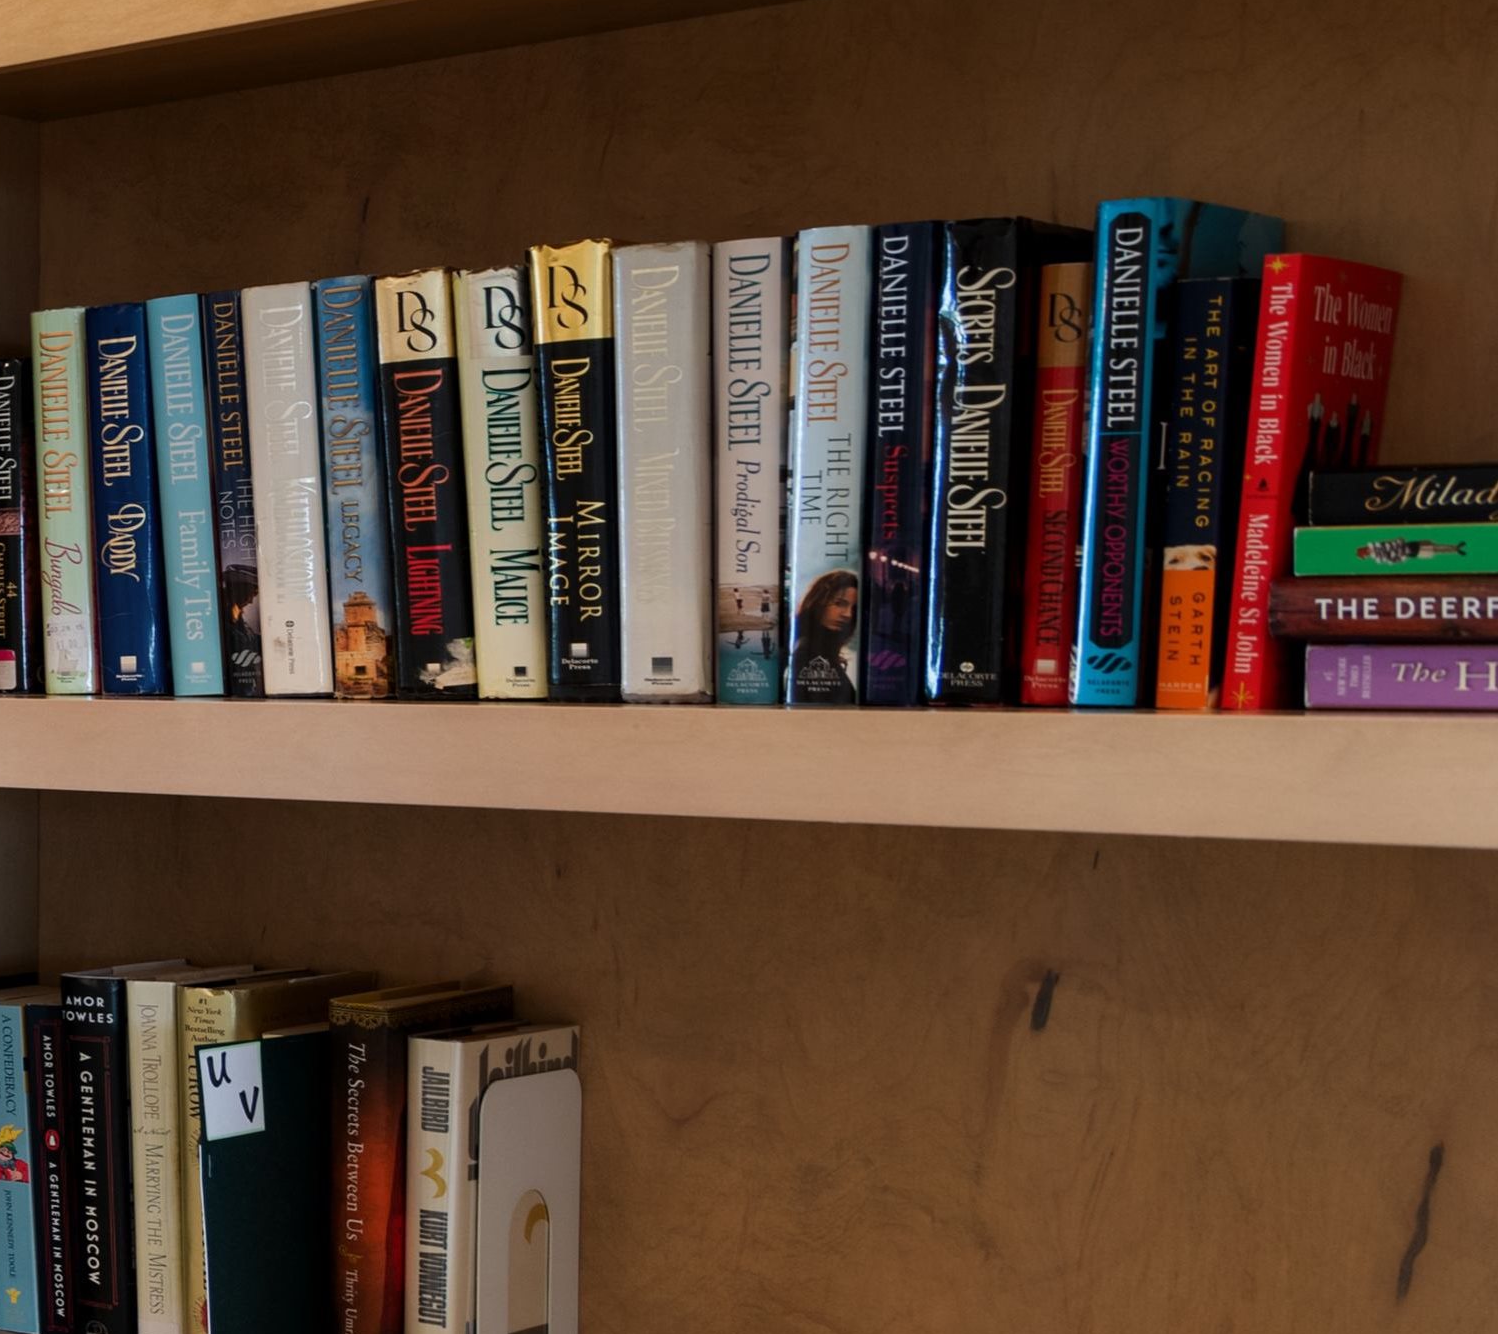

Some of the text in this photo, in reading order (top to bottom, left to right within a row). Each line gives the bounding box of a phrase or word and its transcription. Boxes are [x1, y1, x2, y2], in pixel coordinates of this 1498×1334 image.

[1107, 227, 1143, 428] DANIELLE STEEL
[1253, 282, 1294, 466] The Women in Black
[97, 336, 146, 582] DANIELLE STEEL DADDY
[728, 253, 771, 574] DANIELLE STEEL Prodigal Son
[1175, 337, 1198, 487] IN THE RAIN
[1194, 295, 1223, 528] THE ART OF RACING
[340, 501, 363, 584] LEGACY
[481, 369, 540, 626] DANIELLE STEEL MALICE
[800, 470, 823, 525] TIME
[824, 433, 851, 562] THE RIGHT
[174, 510, 212, 641] Family Ties
[405, 543, 452, 635] LIGHTNING
[548, 516, 570, 607] IMAGE
[576, 500, 606, 622] MIRROR
[1234, 513, 1271, 675] Madeleine St John
[1314, 598, 1379, 619] THE
[1166, 595, 1182, 662] STEIN
[1190, 593, 1205, 666] GARTH
[62, 1010, 114, 1024] TOWLES
[65, 995, 105, 1008] AMOR
[240, 1087, 259, 1122] V
[346, 1042, 366, 1242] The Secrets Between Us
[421, 1067, 450, 1133] JAILBIRD
[79, 1051, 101, 1286] A GENTLEMAN IN MOSCOW
[418, 1209, 448, 1328] KURT VONNEGUT
